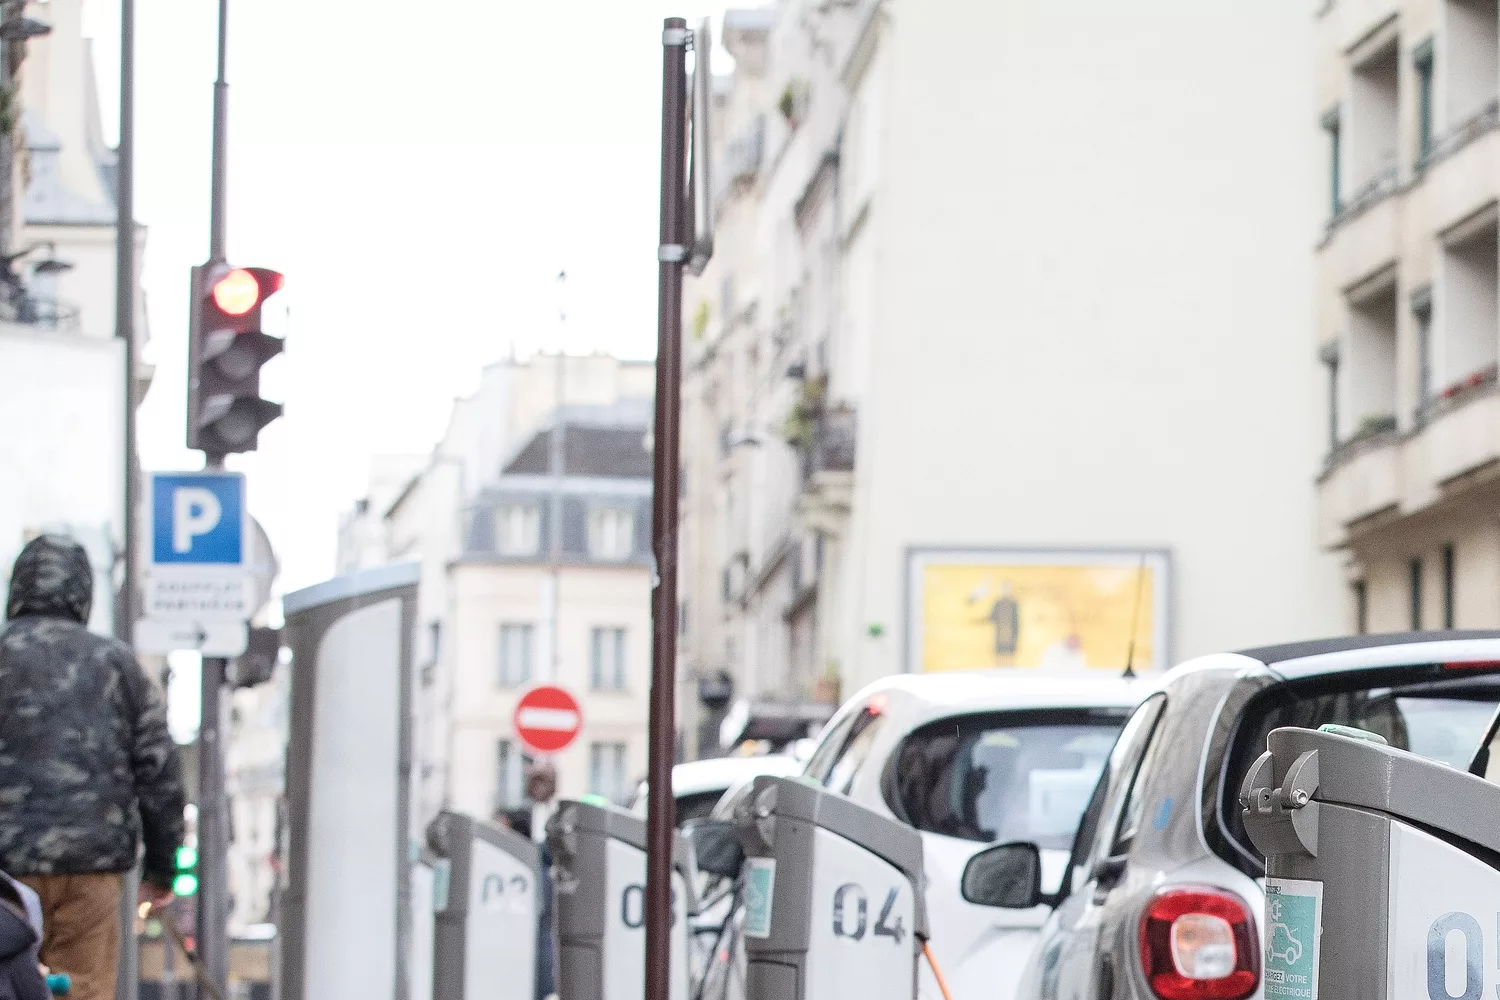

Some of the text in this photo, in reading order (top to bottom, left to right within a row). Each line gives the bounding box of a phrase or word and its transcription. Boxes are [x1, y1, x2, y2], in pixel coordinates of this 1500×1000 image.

[173, 487, 222, 553] P
[833, 882, 905, 944] 04
[1285, 973, 1308, 984] VOTRE
